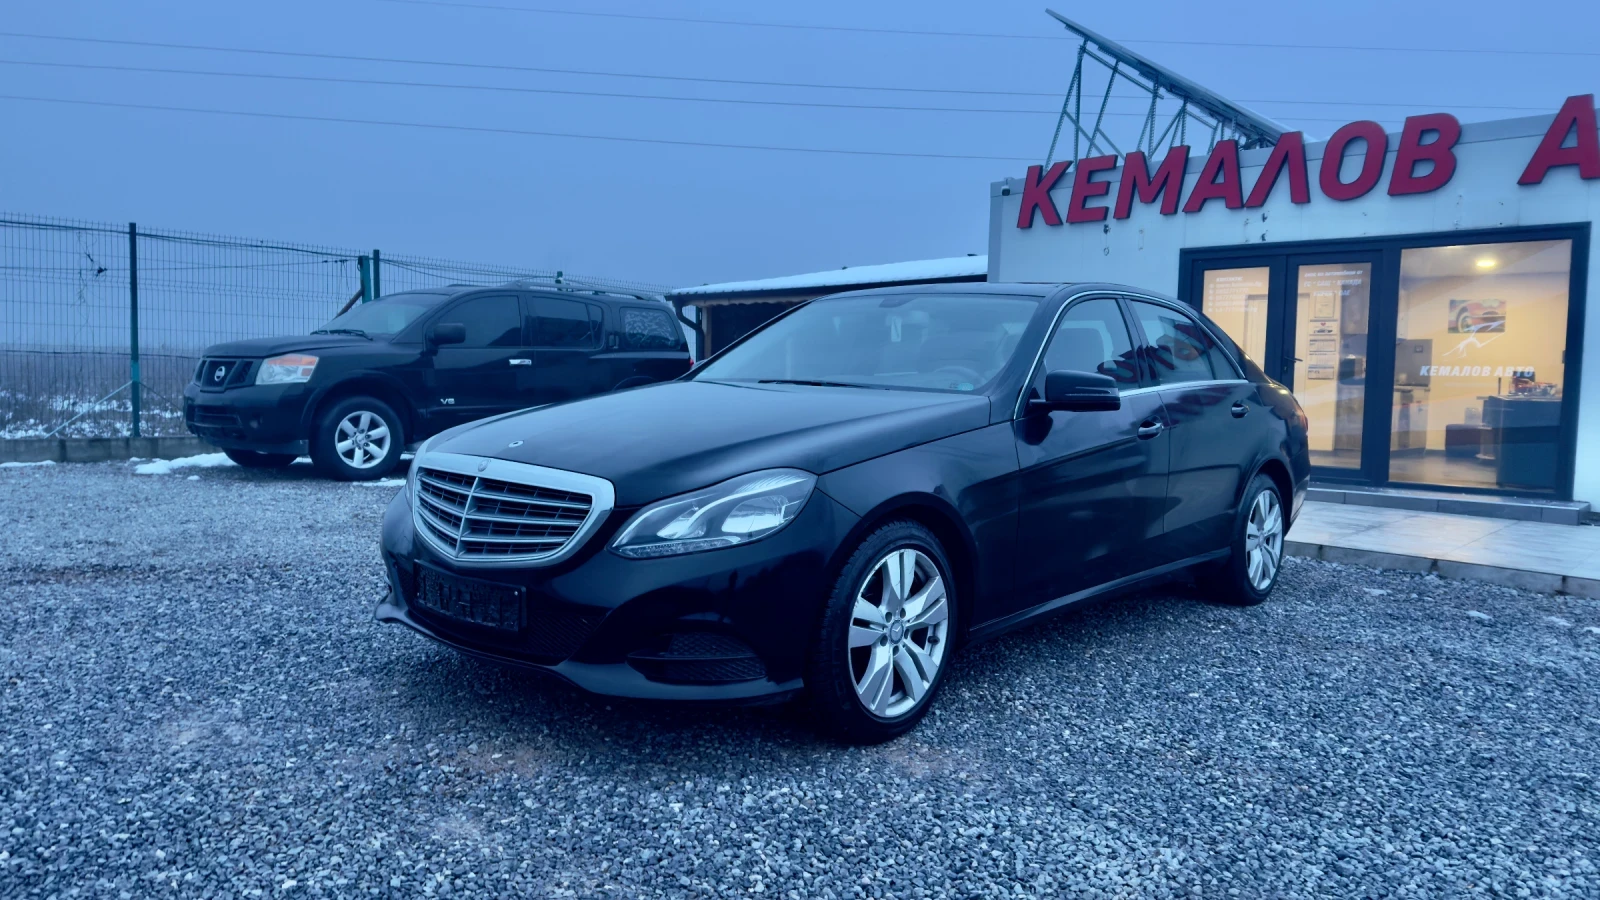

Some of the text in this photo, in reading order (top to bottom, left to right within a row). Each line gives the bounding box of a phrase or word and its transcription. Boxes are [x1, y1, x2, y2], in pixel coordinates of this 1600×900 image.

[1017, 113, 1462, 229] КЕМАЛОВ
[1420, 366, 1535, 376] КЕМАЛОВ АВТО
